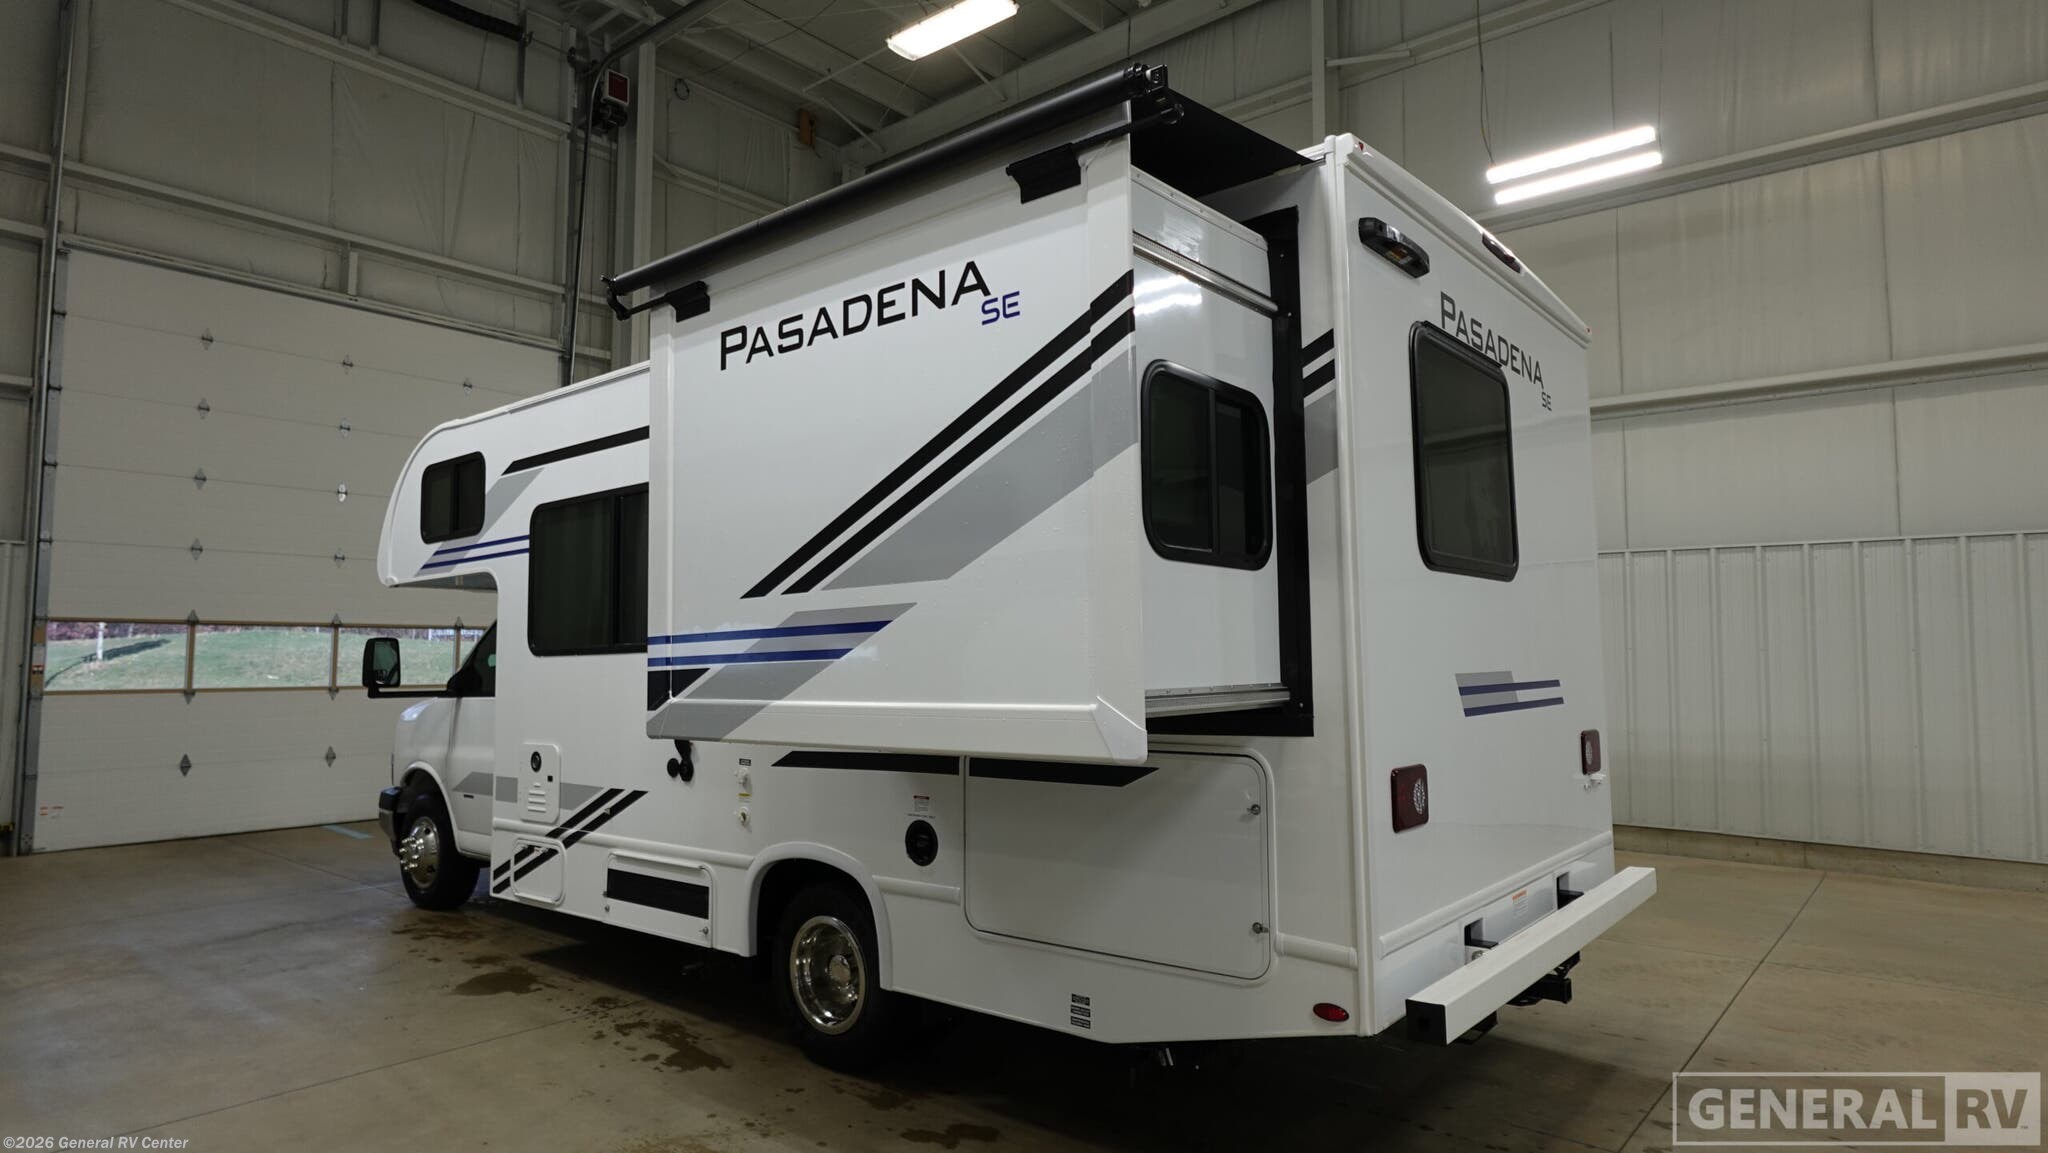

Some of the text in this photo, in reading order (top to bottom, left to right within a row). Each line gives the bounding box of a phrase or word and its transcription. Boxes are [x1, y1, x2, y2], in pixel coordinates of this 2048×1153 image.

[720, 260, 992, 371] PASADENA
[980, 290, 1021, 326] SE
[1440, 291, 1545, 389] PASADENA
[1541, 391, 1552, 412] SE
